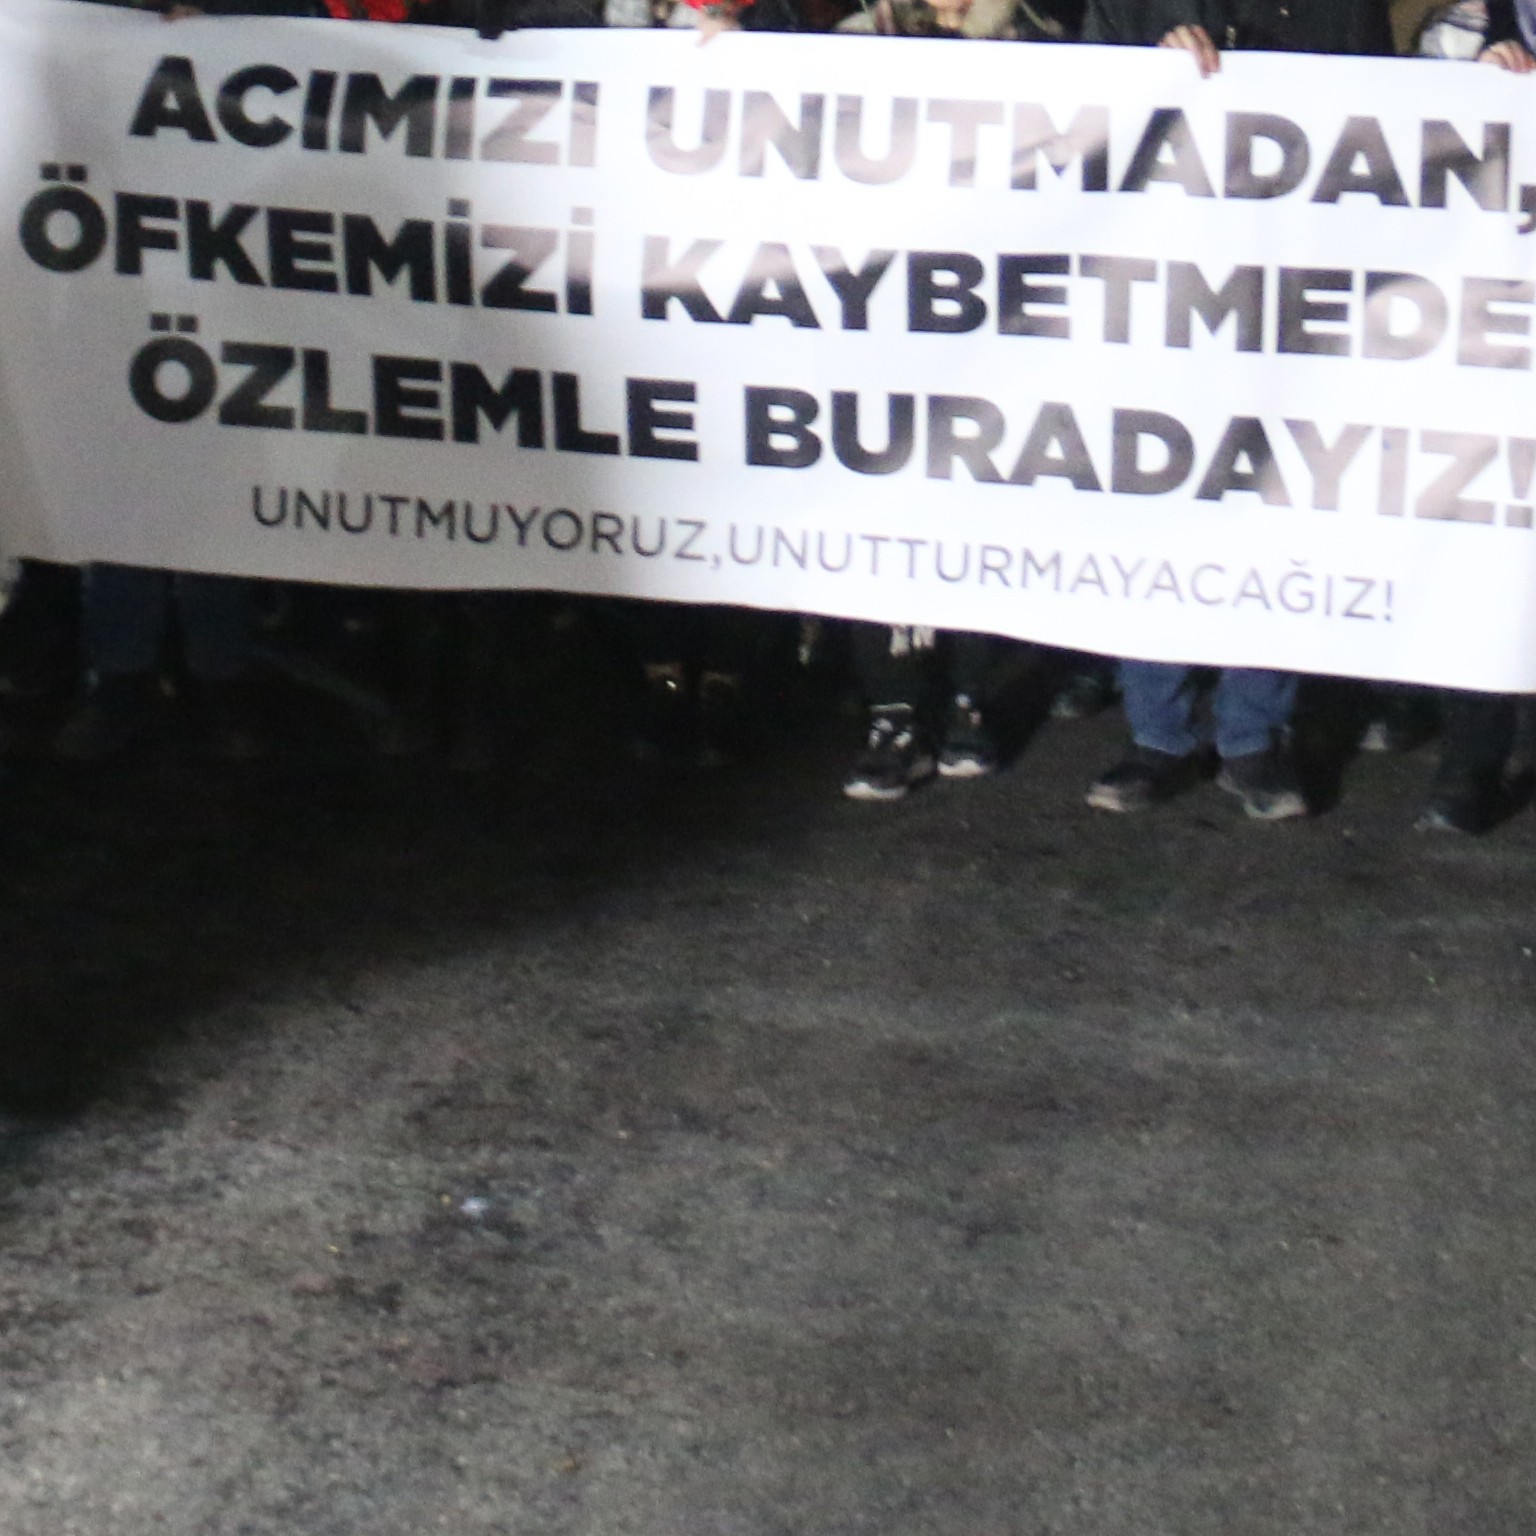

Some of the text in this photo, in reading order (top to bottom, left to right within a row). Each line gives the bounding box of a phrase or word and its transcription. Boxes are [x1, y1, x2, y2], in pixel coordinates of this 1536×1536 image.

[129, 56, 600, 167] ACIMIZI
[19, 163, 594, 316] ÖFKEMİZİ
[129, 314, 698, 461] ÖZLEMLE
